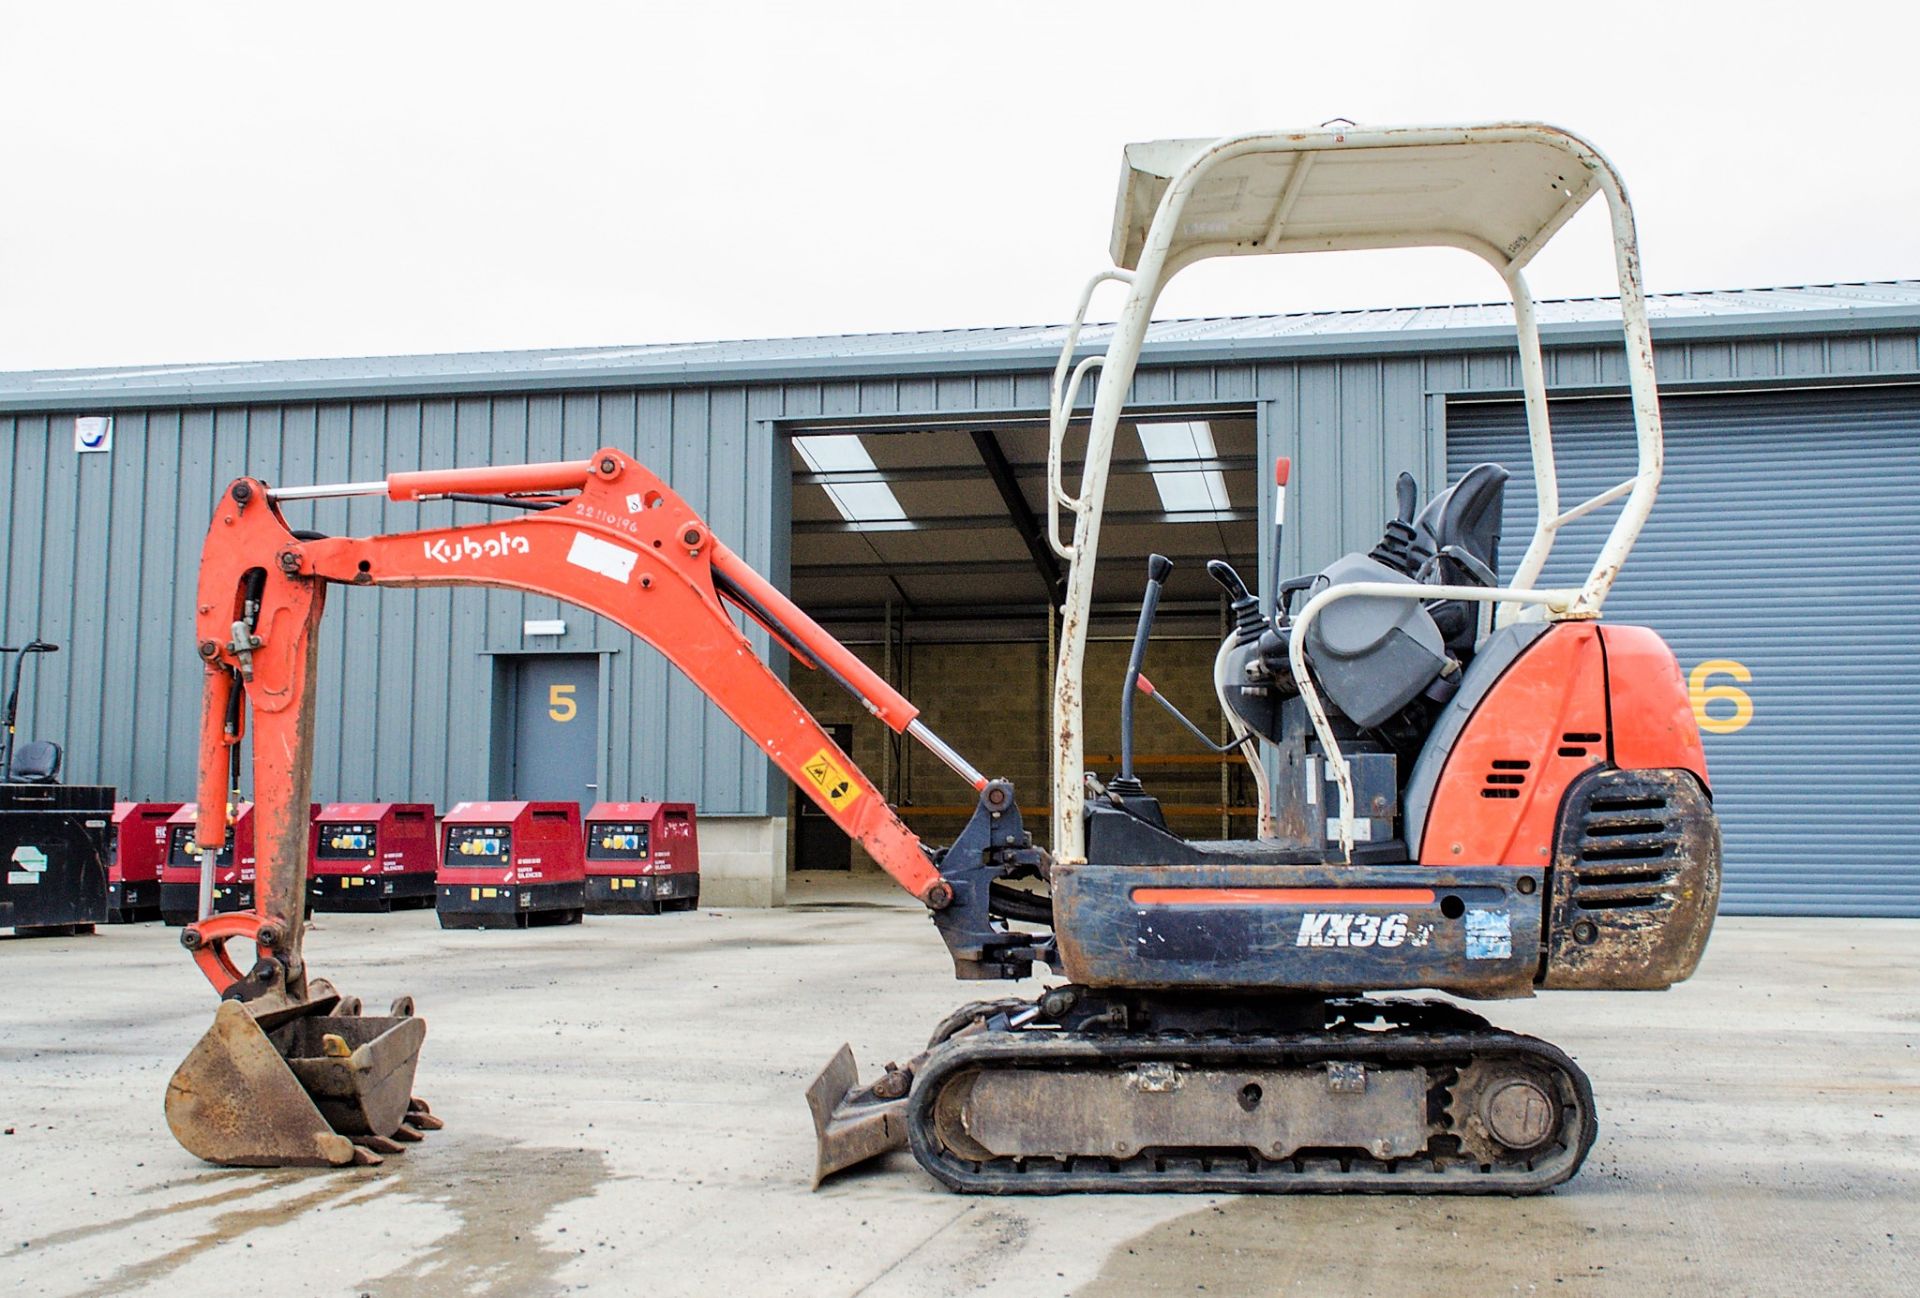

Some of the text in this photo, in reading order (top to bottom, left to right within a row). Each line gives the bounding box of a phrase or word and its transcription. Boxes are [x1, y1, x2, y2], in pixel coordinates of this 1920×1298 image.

[423, 531, 530, 563] Kubota
[549, 684, 577, 722] 5
[1689, 659, 1754, 733] 6
